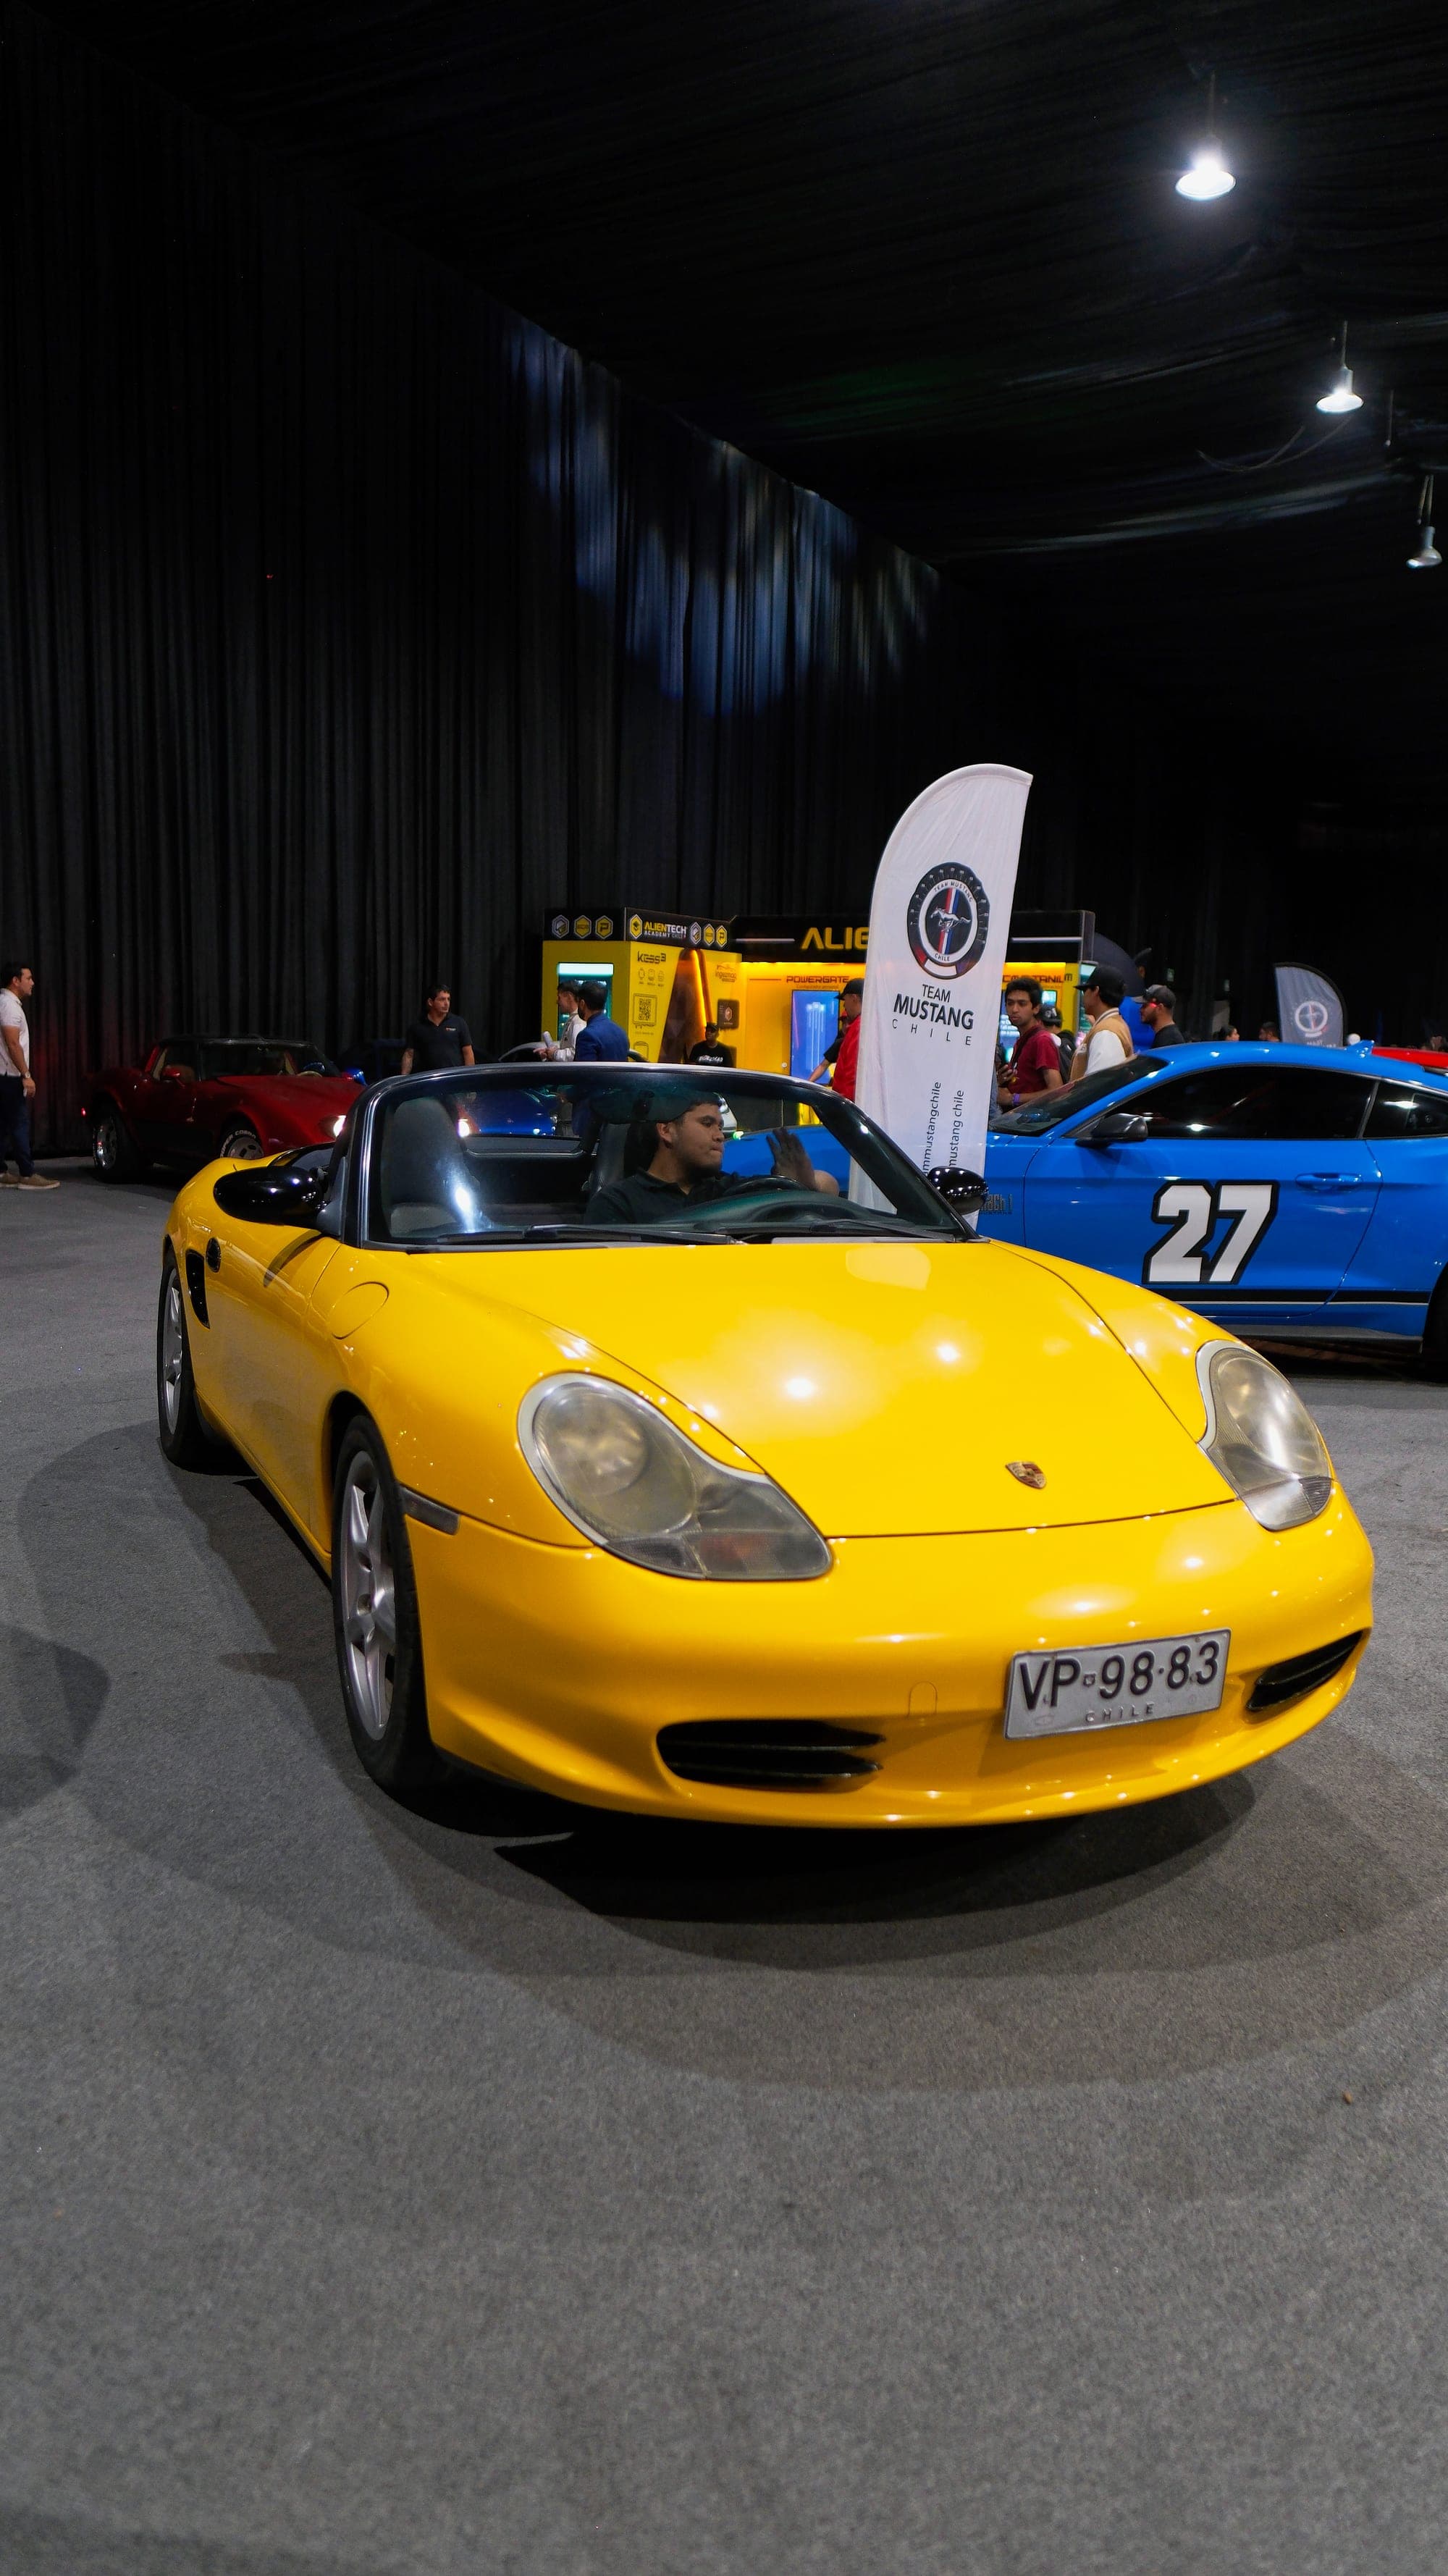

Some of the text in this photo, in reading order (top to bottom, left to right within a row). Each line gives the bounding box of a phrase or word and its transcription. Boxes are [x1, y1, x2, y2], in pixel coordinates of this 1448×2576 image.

[934, 881, 974, 902] TEAM MUSTANG
[644, 921, 687, 935] ALIENTECH
[801, 927, 870, 949] ALIE
[934, 953, 951, 961] CHILE
[786, 975, 849, 984] POWERGATE
[922, 984, 951, 1003] TEAM
[893, 993, 975, 1030] MUSTANG
[892, 1019, 972, 1045] CHILE
[952, 1090, 964, 1117] chile
[922, 1082, 942, 1176] mmustangchile
[1144, 1182, 1277, 1283] 27
[1085, 1702, 1156, 1722] CHILE
